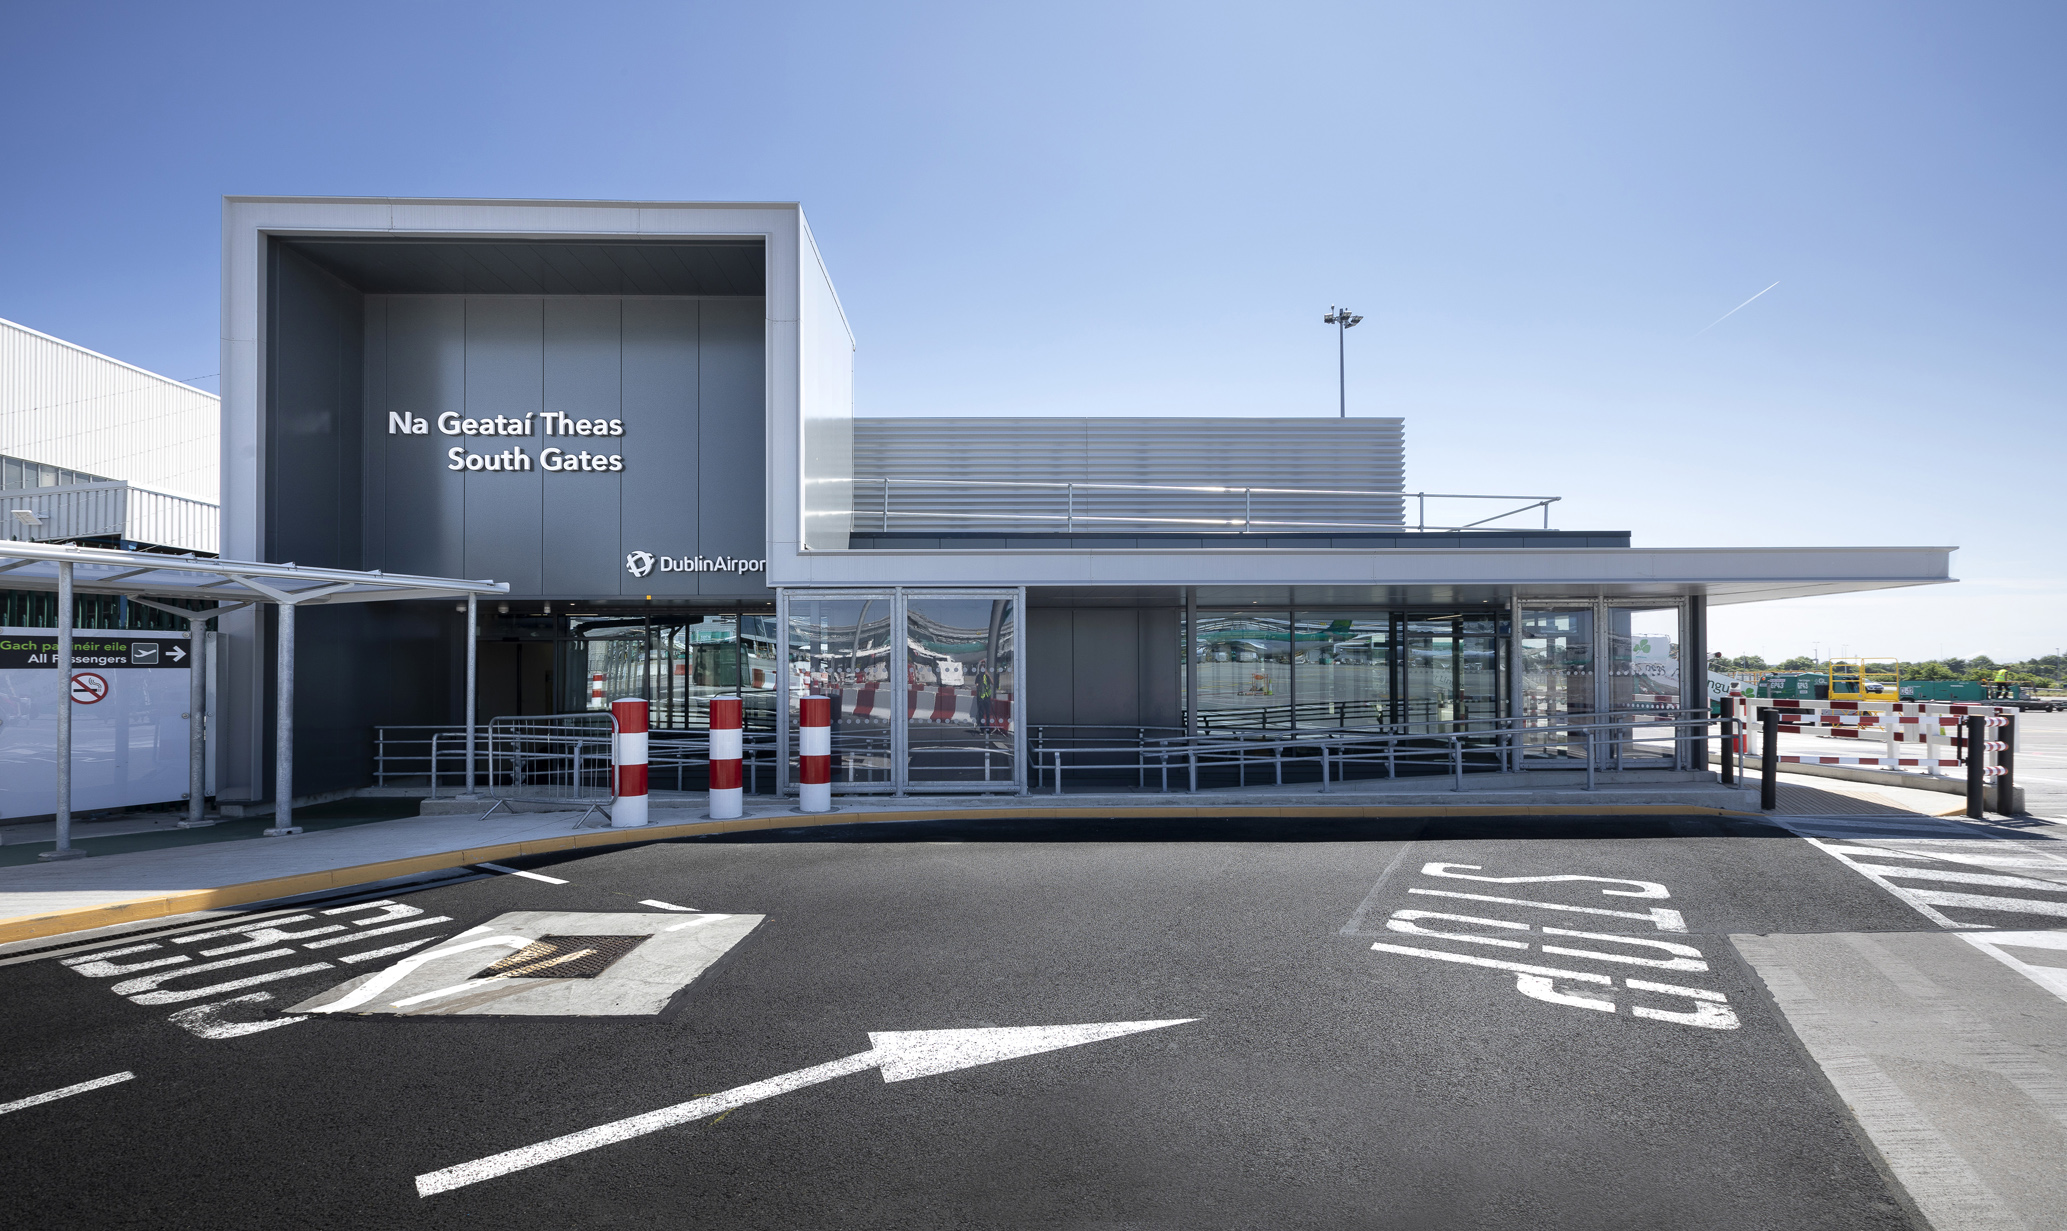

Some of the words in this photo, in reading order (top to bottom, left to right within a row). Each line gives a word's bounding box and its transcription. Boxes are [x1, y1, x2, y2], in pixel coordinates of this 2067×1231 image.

[388, 411, 429, 435] Na
[437, 411, 534, 436] Geataí
[540, 411, 624, 436] Theas
[448, 446, 531, 472] South
[540, 447, 623, 472] Gates
[660, 555, 766, 575] DublinAirpor
[0, 640, 37, 651] Gach
[42, 641, 100, 653] painéir
[103, 641, 127, 652] eile
[27, 653, 47, 664] All
[52, 653, 127, 666] Pssengers
[1707, 679, 1730, 694] ngu
[1370, 862, 1741, 1031] STOP
